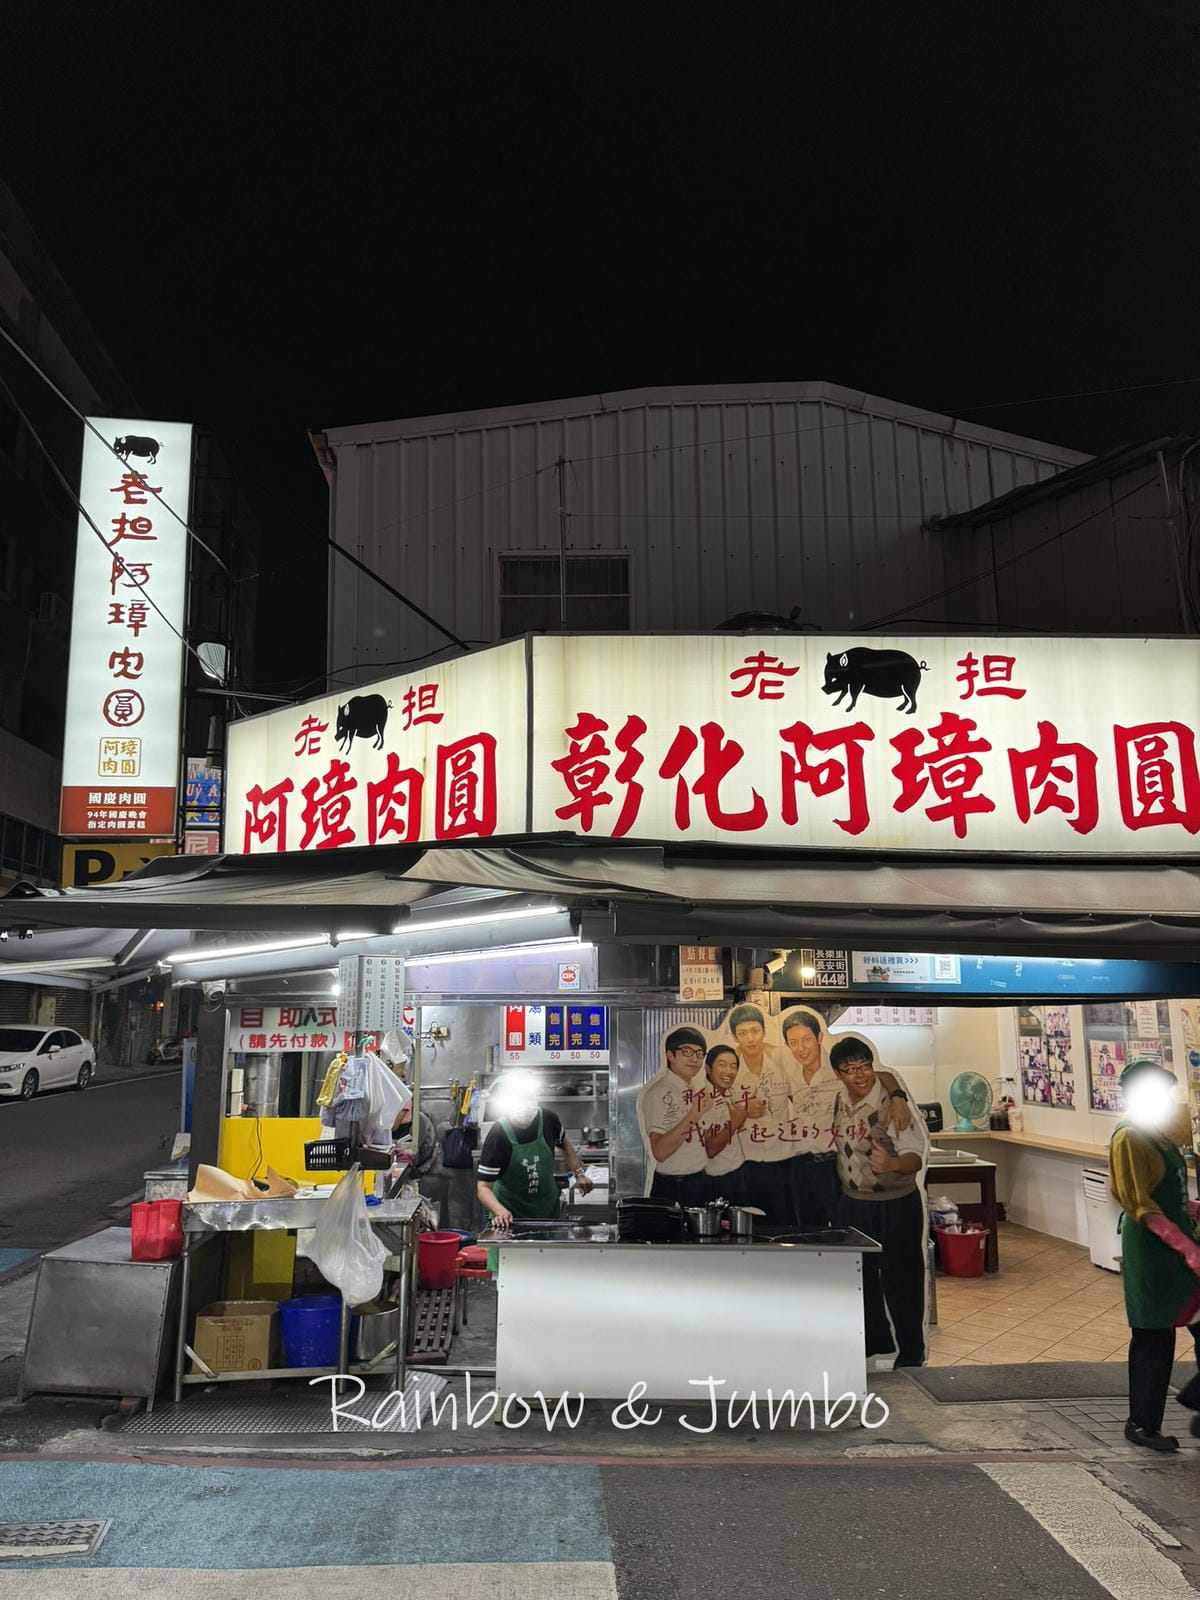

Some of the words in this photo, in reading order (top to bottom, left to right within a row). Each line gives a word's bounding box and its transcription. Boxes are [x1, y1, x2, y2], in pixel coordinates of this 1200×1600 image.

[730, 650, 800, 701] 老
[956, 651, 1027, 701] 担
[294, 714, 329, 757] 老
[402, 683, 444, 730] 担
[103, 740, 138, 757] 阿璋
[102, 757, 136, 775] 肉圓
[550, 711, 1200, 839] 彰化阿璋肉圓
[88, 792, 147, 805] 國慶肉圓
[243, 732, 497, 855] 阿璋肉圓
[816, 973, 846, 985] 144號
[509, 1052, 520, 1061] 55
[550, 1052, 561, 1060] 50
[570, 1052, 581, 1060] 50
[590, 1051, 601, 1059] 50
